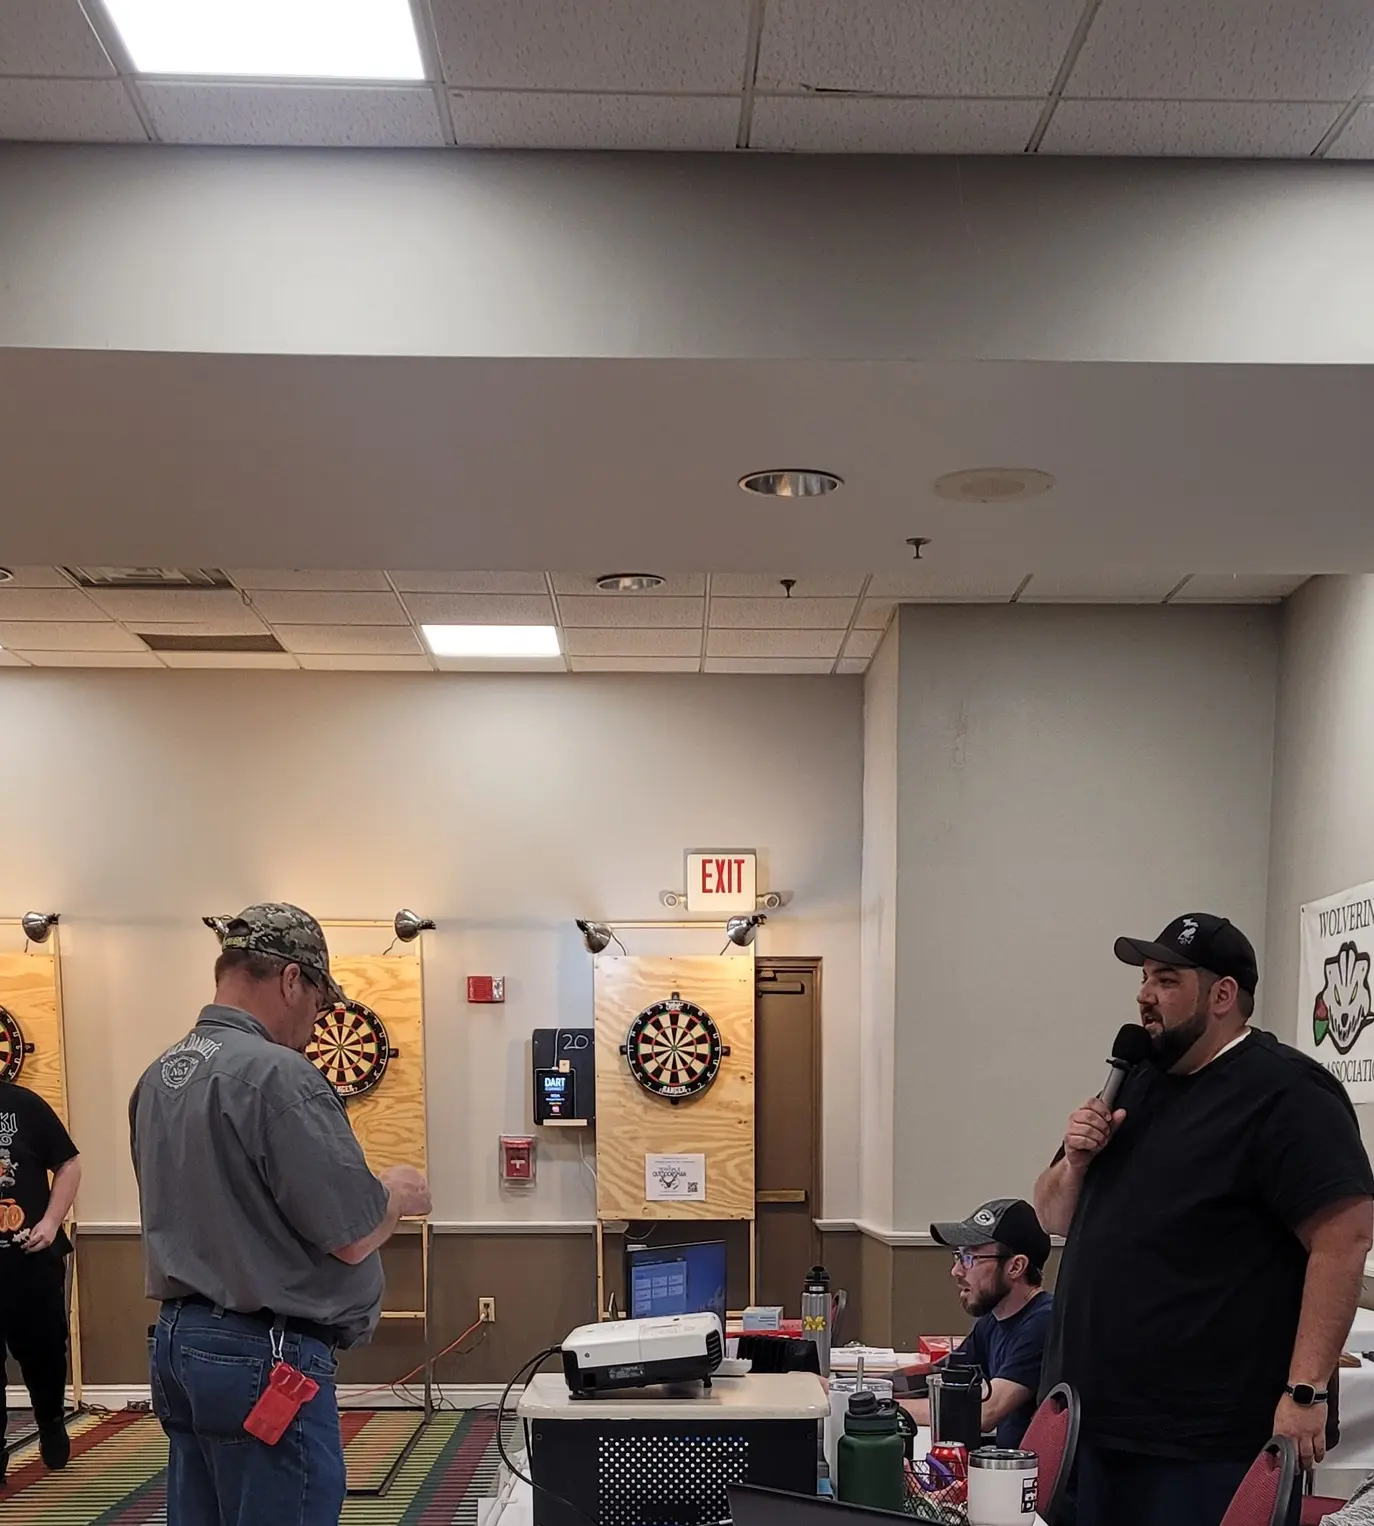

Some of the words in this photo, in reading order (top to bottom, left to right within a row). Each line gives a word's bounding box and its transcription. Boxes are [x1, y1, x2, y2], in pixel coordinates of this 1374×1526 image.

[702, 858, 745, 894] EXIT
[562, 1034, 589, 1050] 20
[1327, 1059, 1374, 1083] SSOCIATI
[544, 1077, 566, 1087] DART
